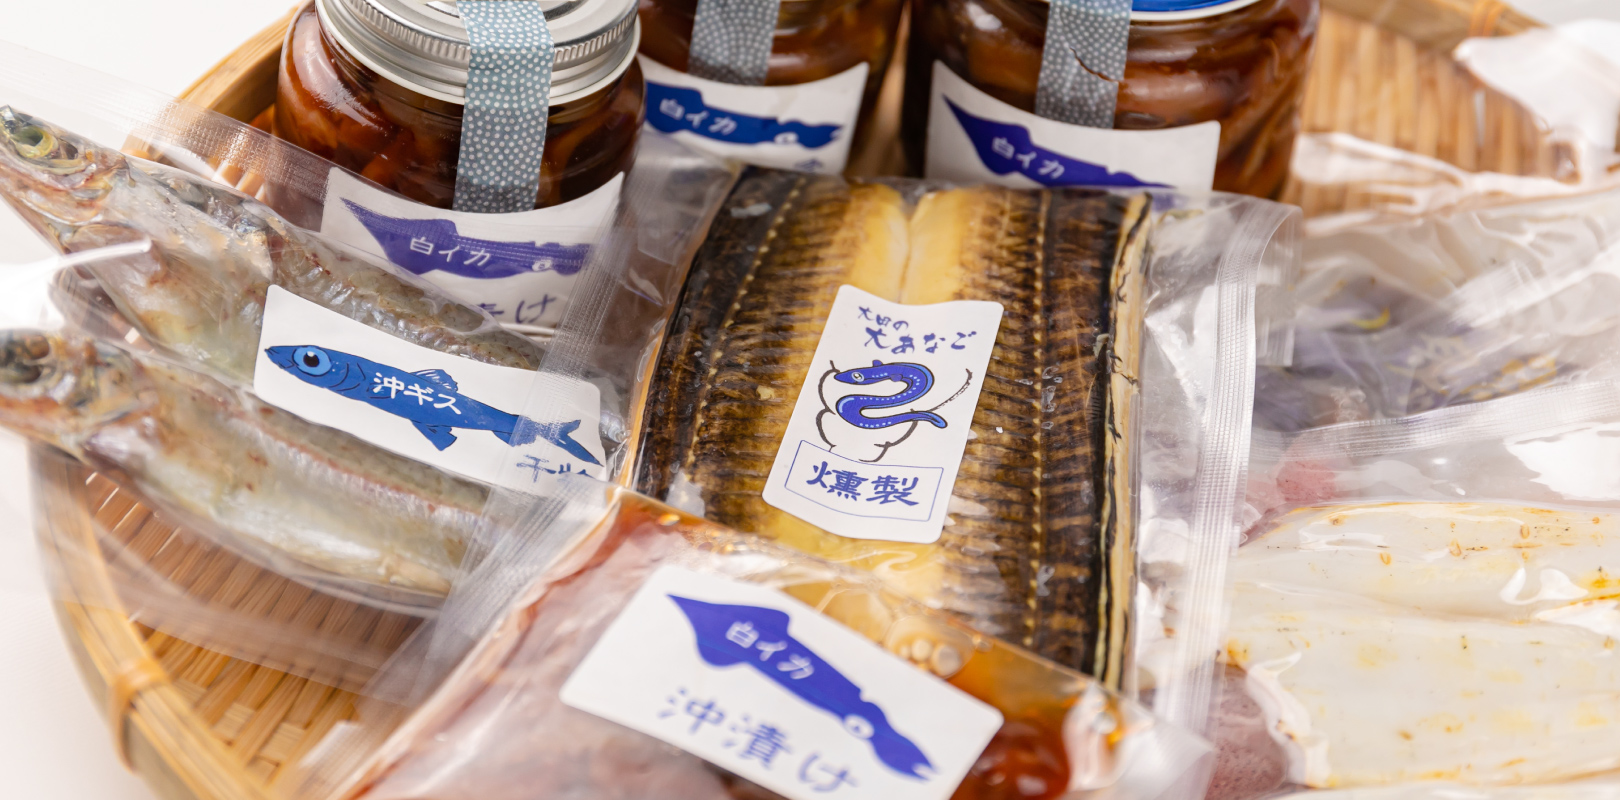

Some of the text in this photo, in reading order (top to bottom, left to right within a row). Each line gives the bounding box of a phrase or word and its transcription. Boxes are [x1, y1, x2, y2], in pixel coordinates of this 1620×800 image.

[659, 99, 738, 135] 白イカ
[991, 137, 1066, 179] 白イカ
[409, 236, 491, 266] 白イカ
[476, 293, 557, 324] け
[857, 306, 909, 331] 大田の
[864, 326, 977, 354] 大あなご
[373, 372, 462, 415] 沖ギス
[806, 461, 920, 506] 燻製
[725, 620, 815, 680] 白イカ
[657, 686, 859, 793] 沖漬け
